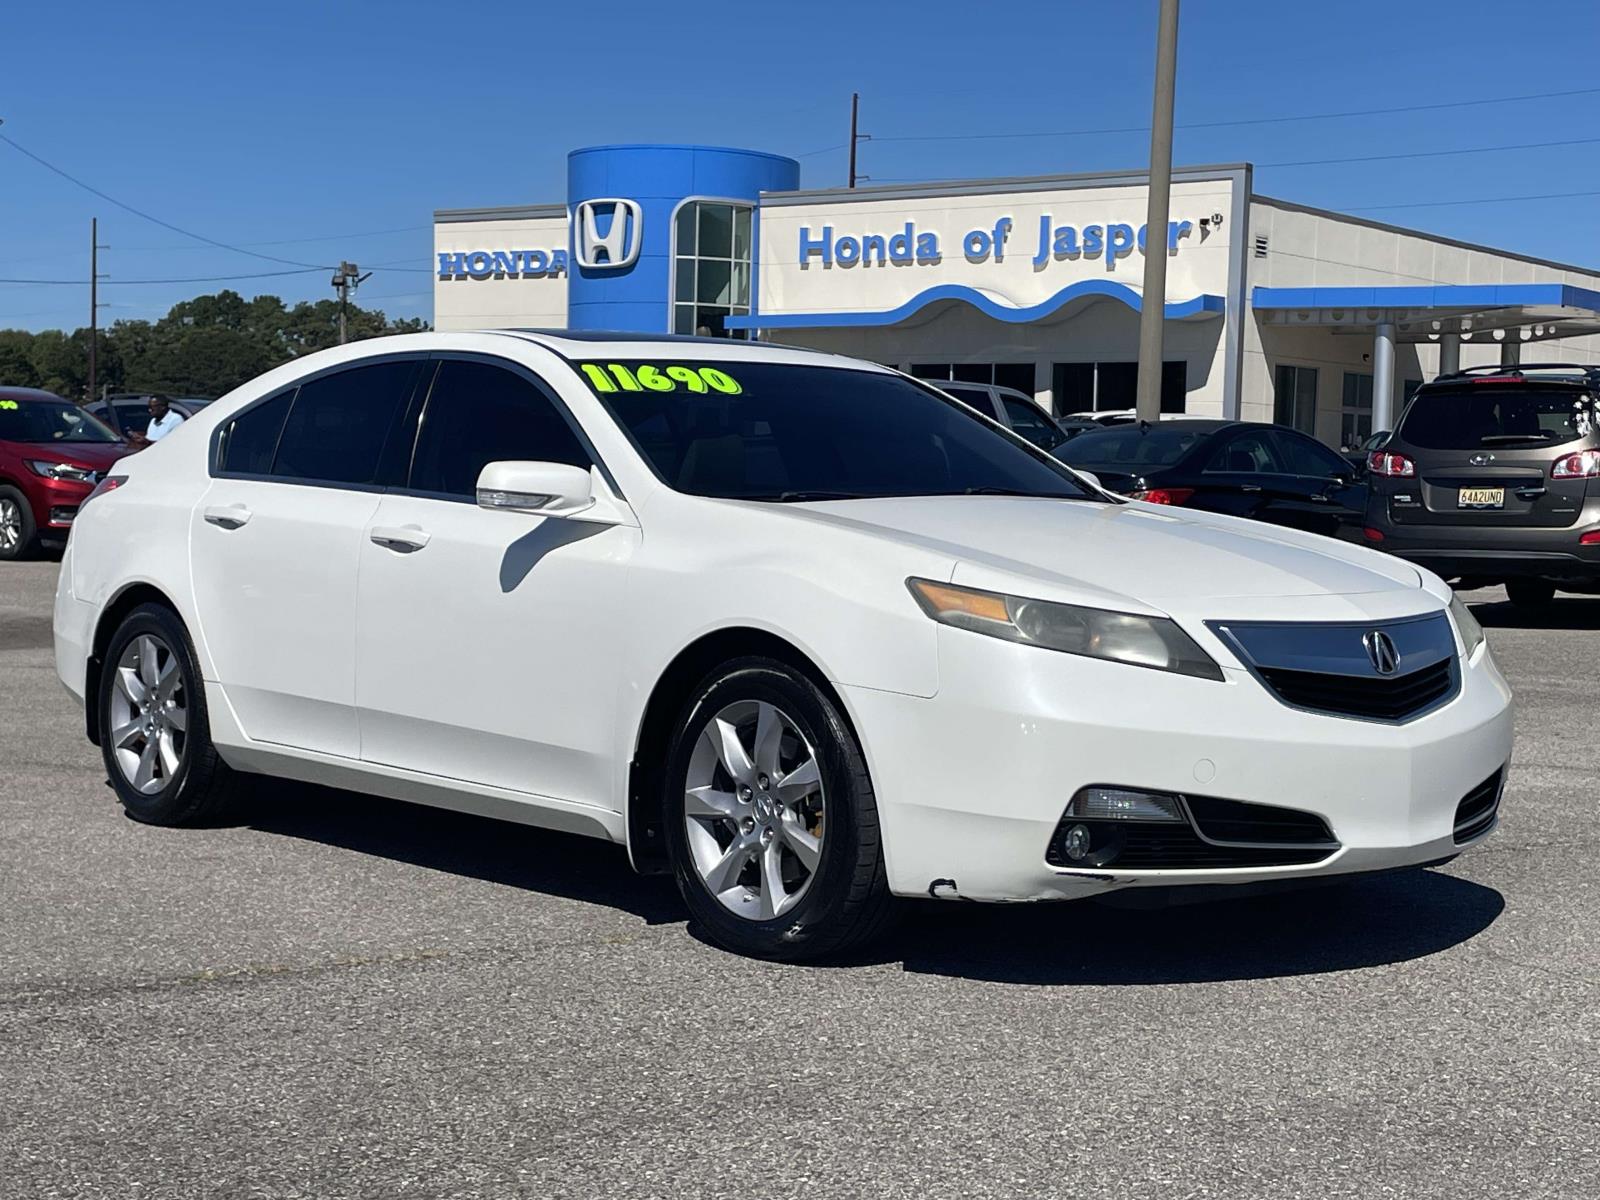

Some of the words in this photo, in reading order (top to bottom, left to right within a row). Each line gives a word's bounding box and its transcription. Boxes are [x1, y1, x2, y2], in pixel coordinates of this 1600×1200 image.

[798, 223, 939, 267] Honda
[963, 216, 1011, 260] of
[437, 248, 567, 280] HONDA
[580, 363, 743, 395] 11690
